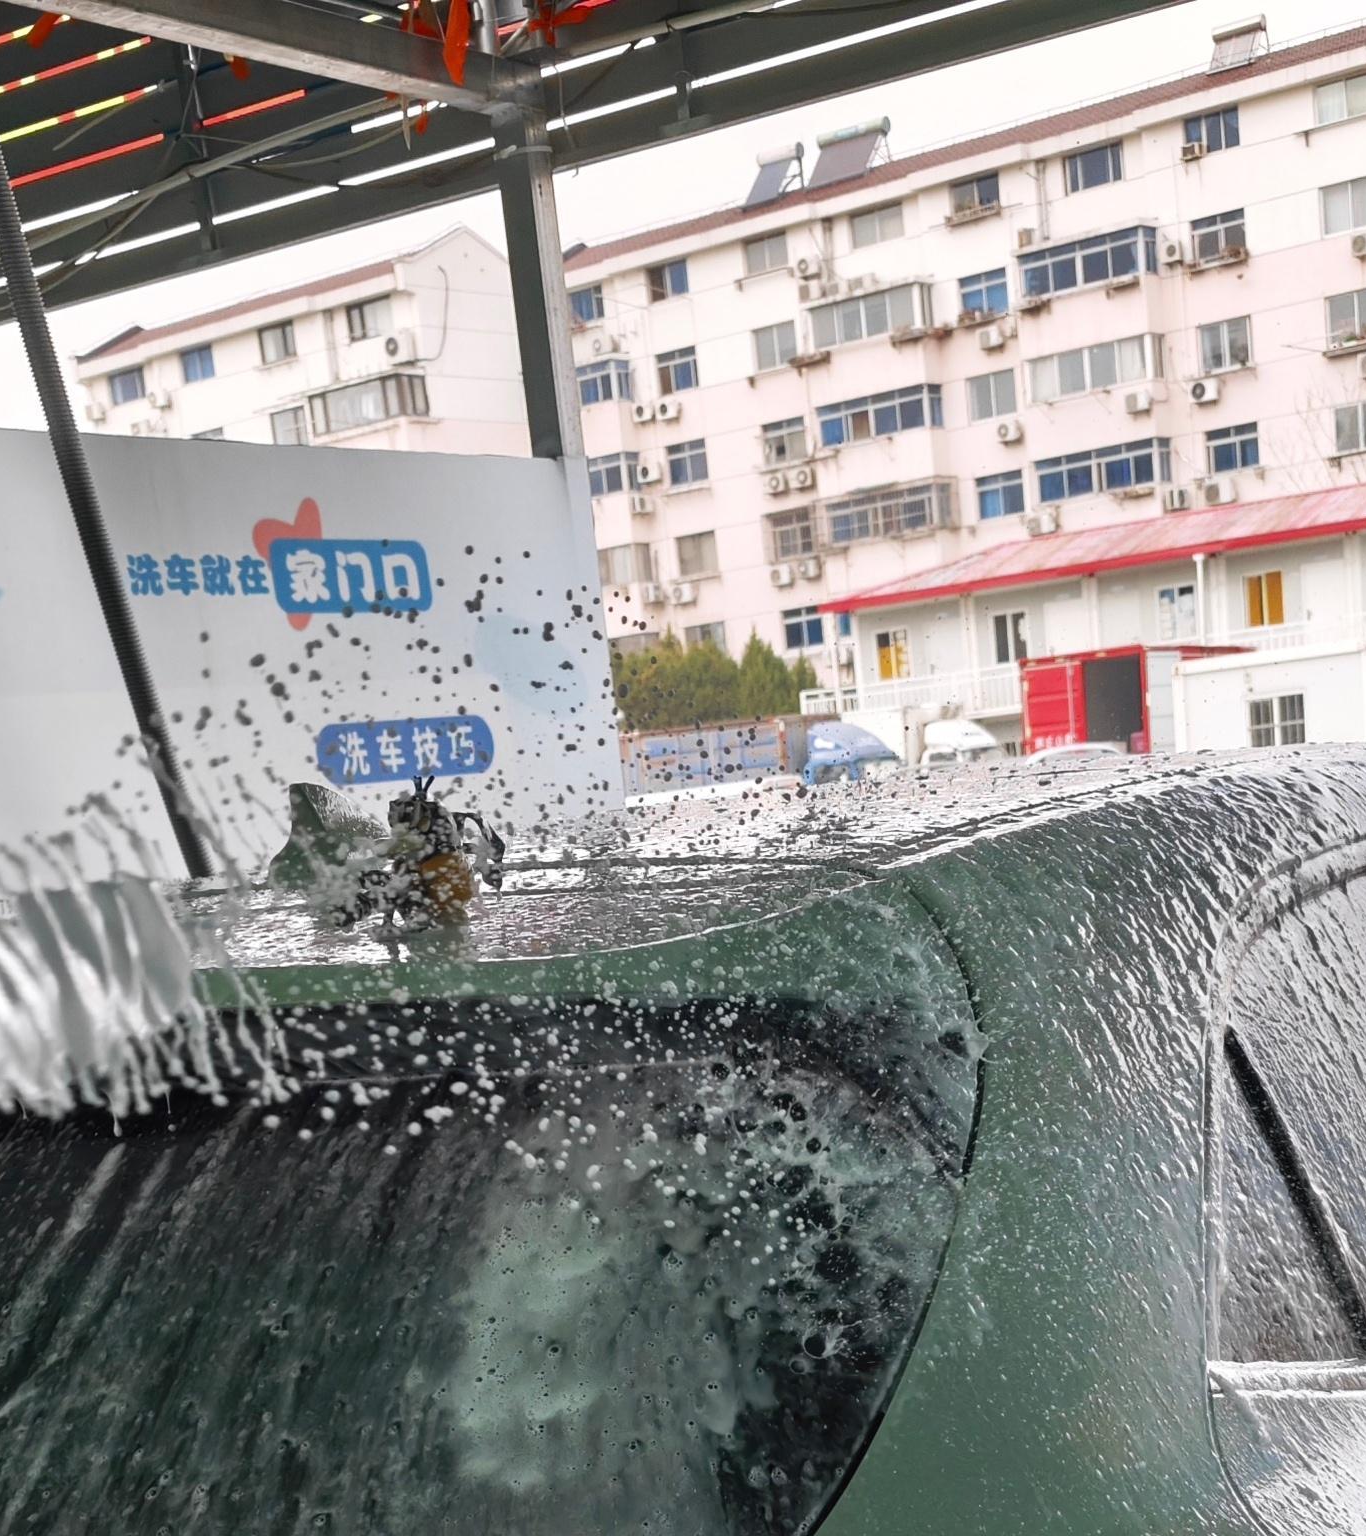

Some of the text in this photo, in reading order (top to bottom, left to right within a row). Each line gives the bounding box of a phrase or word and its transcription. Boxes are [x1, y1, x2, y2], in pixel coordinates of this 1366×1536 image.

[126, 550, 423, 605] 洗车就在 家门口
[338, 730, 476, 776] 洗车技巧
